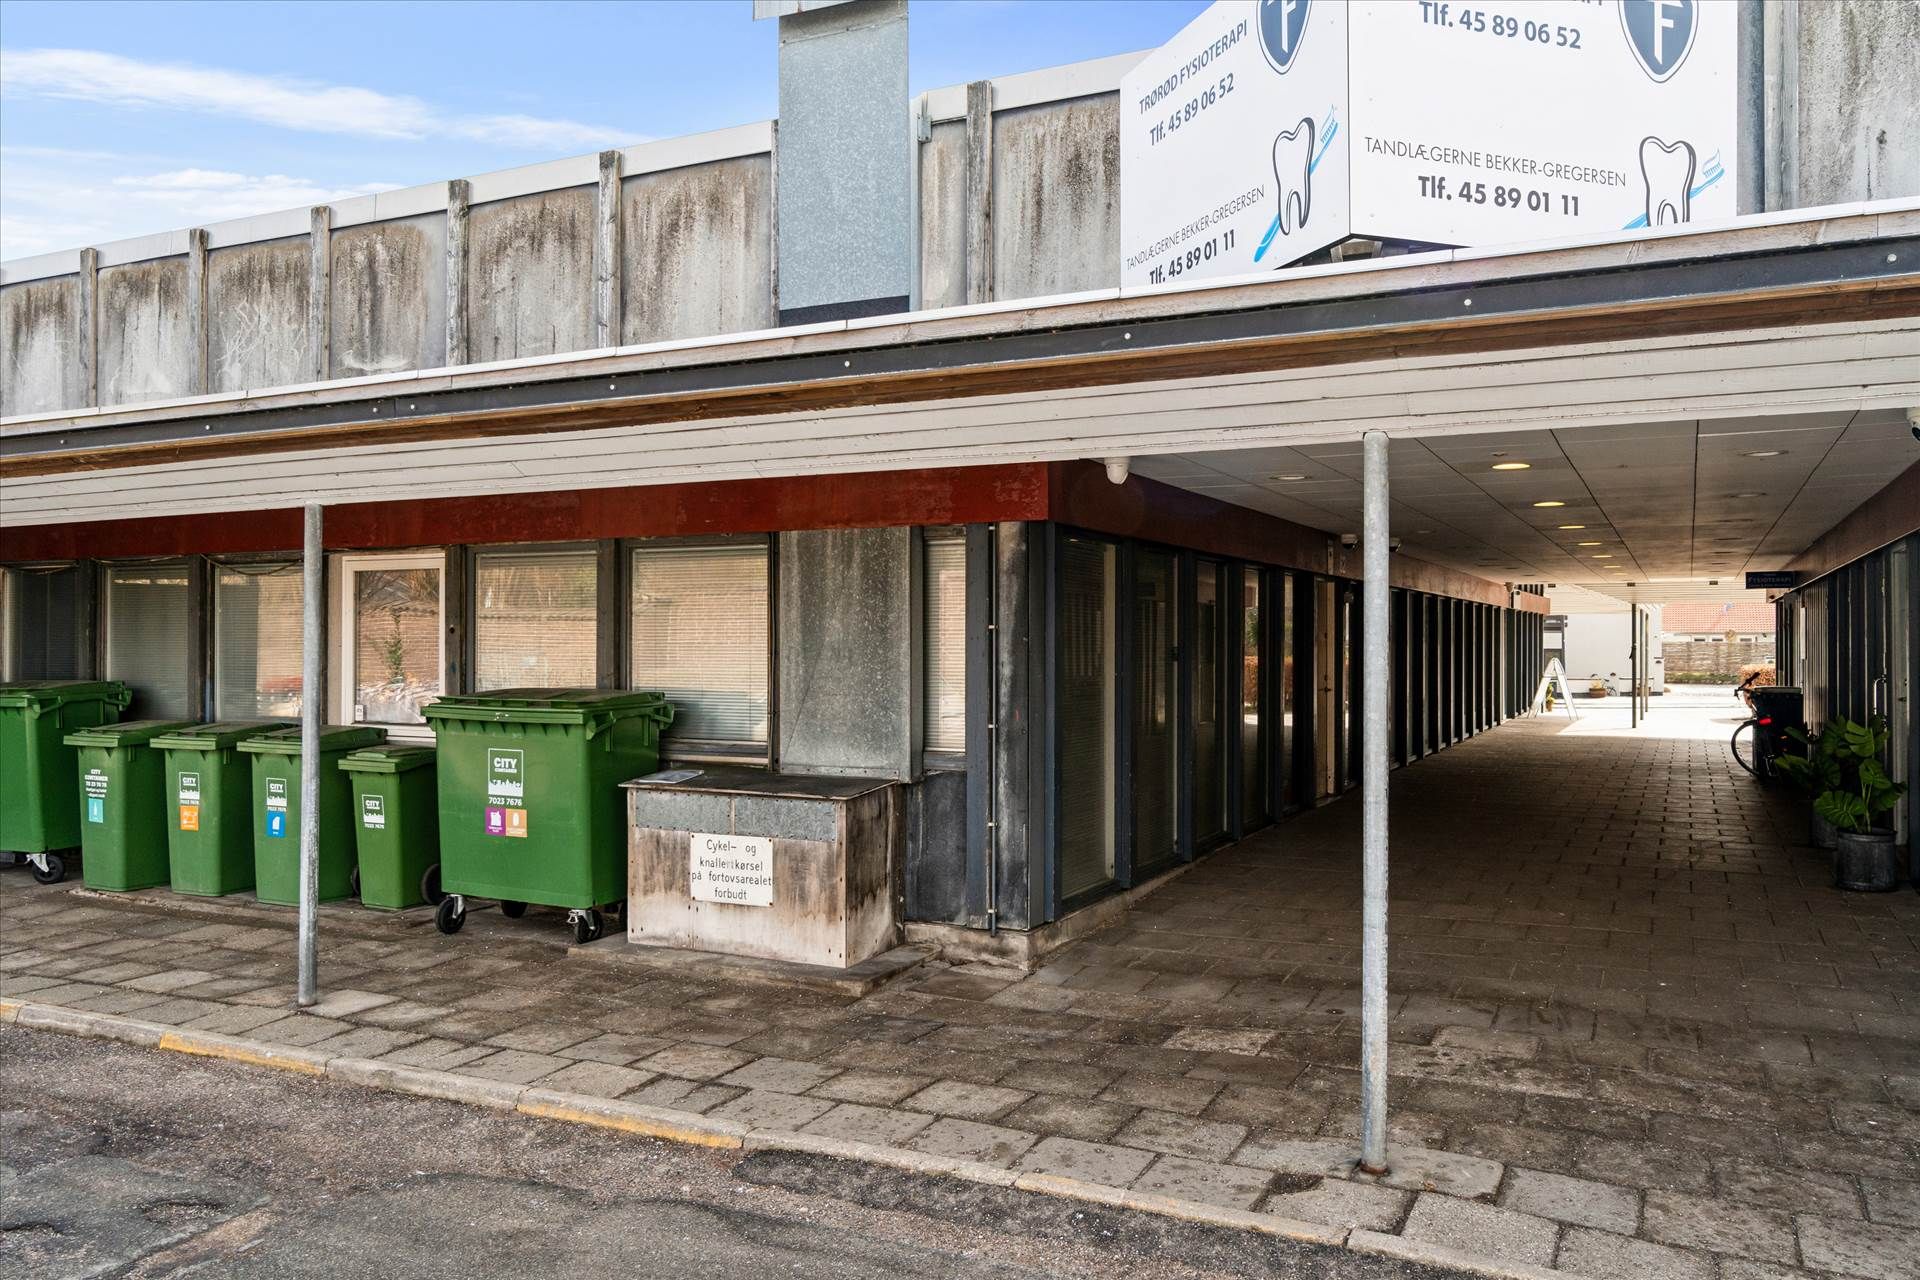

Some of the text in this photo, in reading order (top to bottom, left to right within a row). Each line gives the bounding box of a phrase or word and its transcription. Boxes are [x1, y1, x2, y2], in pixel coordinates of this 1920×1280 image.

[1418, 1, 1582, 49] Tlf. 45 89 06 52
[1139, 19, 1247, 114] TRØRØD FYSIOTERAPI
[1149, 73, 1234, 146] Tlf. 45 89 06 52
[1364, 137, 1626, 187] TANDLÆGERNE BEKKER-GREGERSEN
[1418, 175, 1579, 217] Tlf. 45 89 01 11
[1126, 184, 1265, 270] TANDLÆGERNE BEKKER-GREGERSEN
[1149, 229, 1235, 284] Tlf. 45 89 01 11
[493, 757, 518, 768] CITY
[488, 796, 505, 806] 7023
[706, 839, 756, 856] Cykel- og
[692, 871, 772, 886] på fortovsarealet
[714, 887, 747, 900] forbudt
